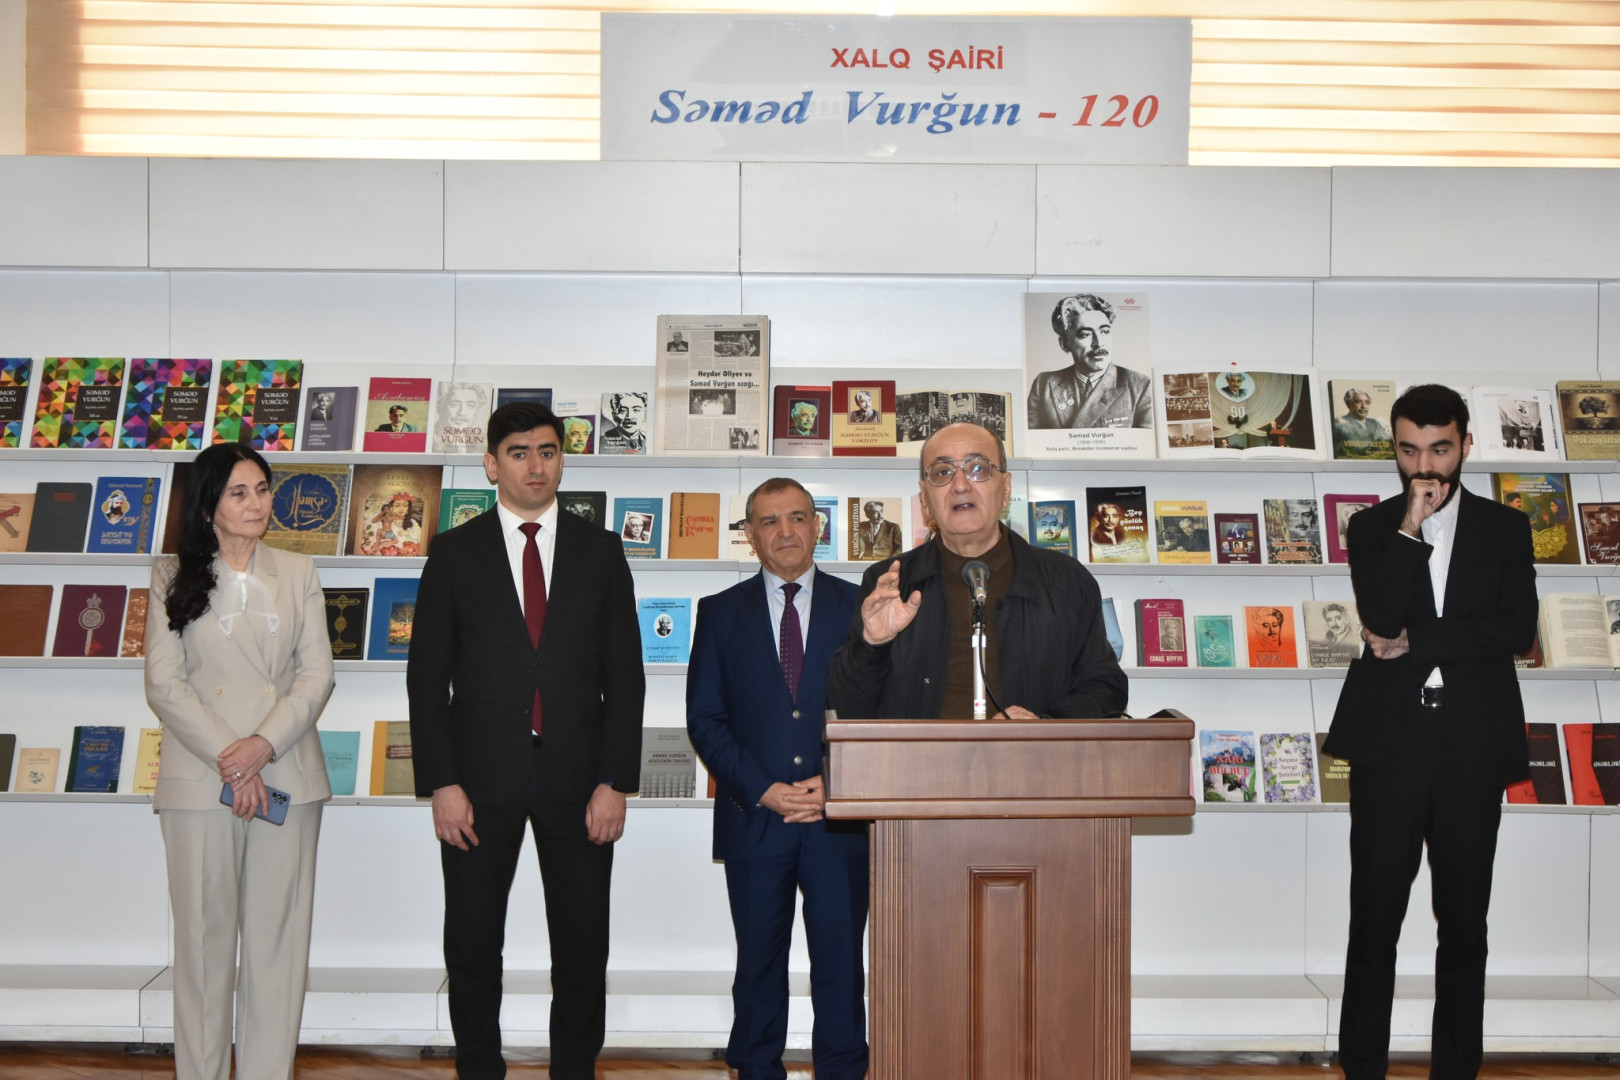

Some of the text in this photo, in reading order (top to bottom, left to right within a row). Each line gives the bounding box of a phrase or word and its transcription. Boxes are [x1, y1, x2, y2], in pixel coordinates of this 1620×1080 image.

[831, 45, 1004, 74] XALQ ŞAİRİ
[650, 89, 814, 126] Səməd
[845, 91, 1021, 134] Vurğun
[1072, 94, 1159, 128] 120
[722, 370, 742, 378] Əliyev
[712, 380, 736, 388] Vurğun
[1230, 406, 1245, 419] 90
[443, 426, 482, 435] SƏMƏD
[1597, 551, 1620, 563] Vurğ
